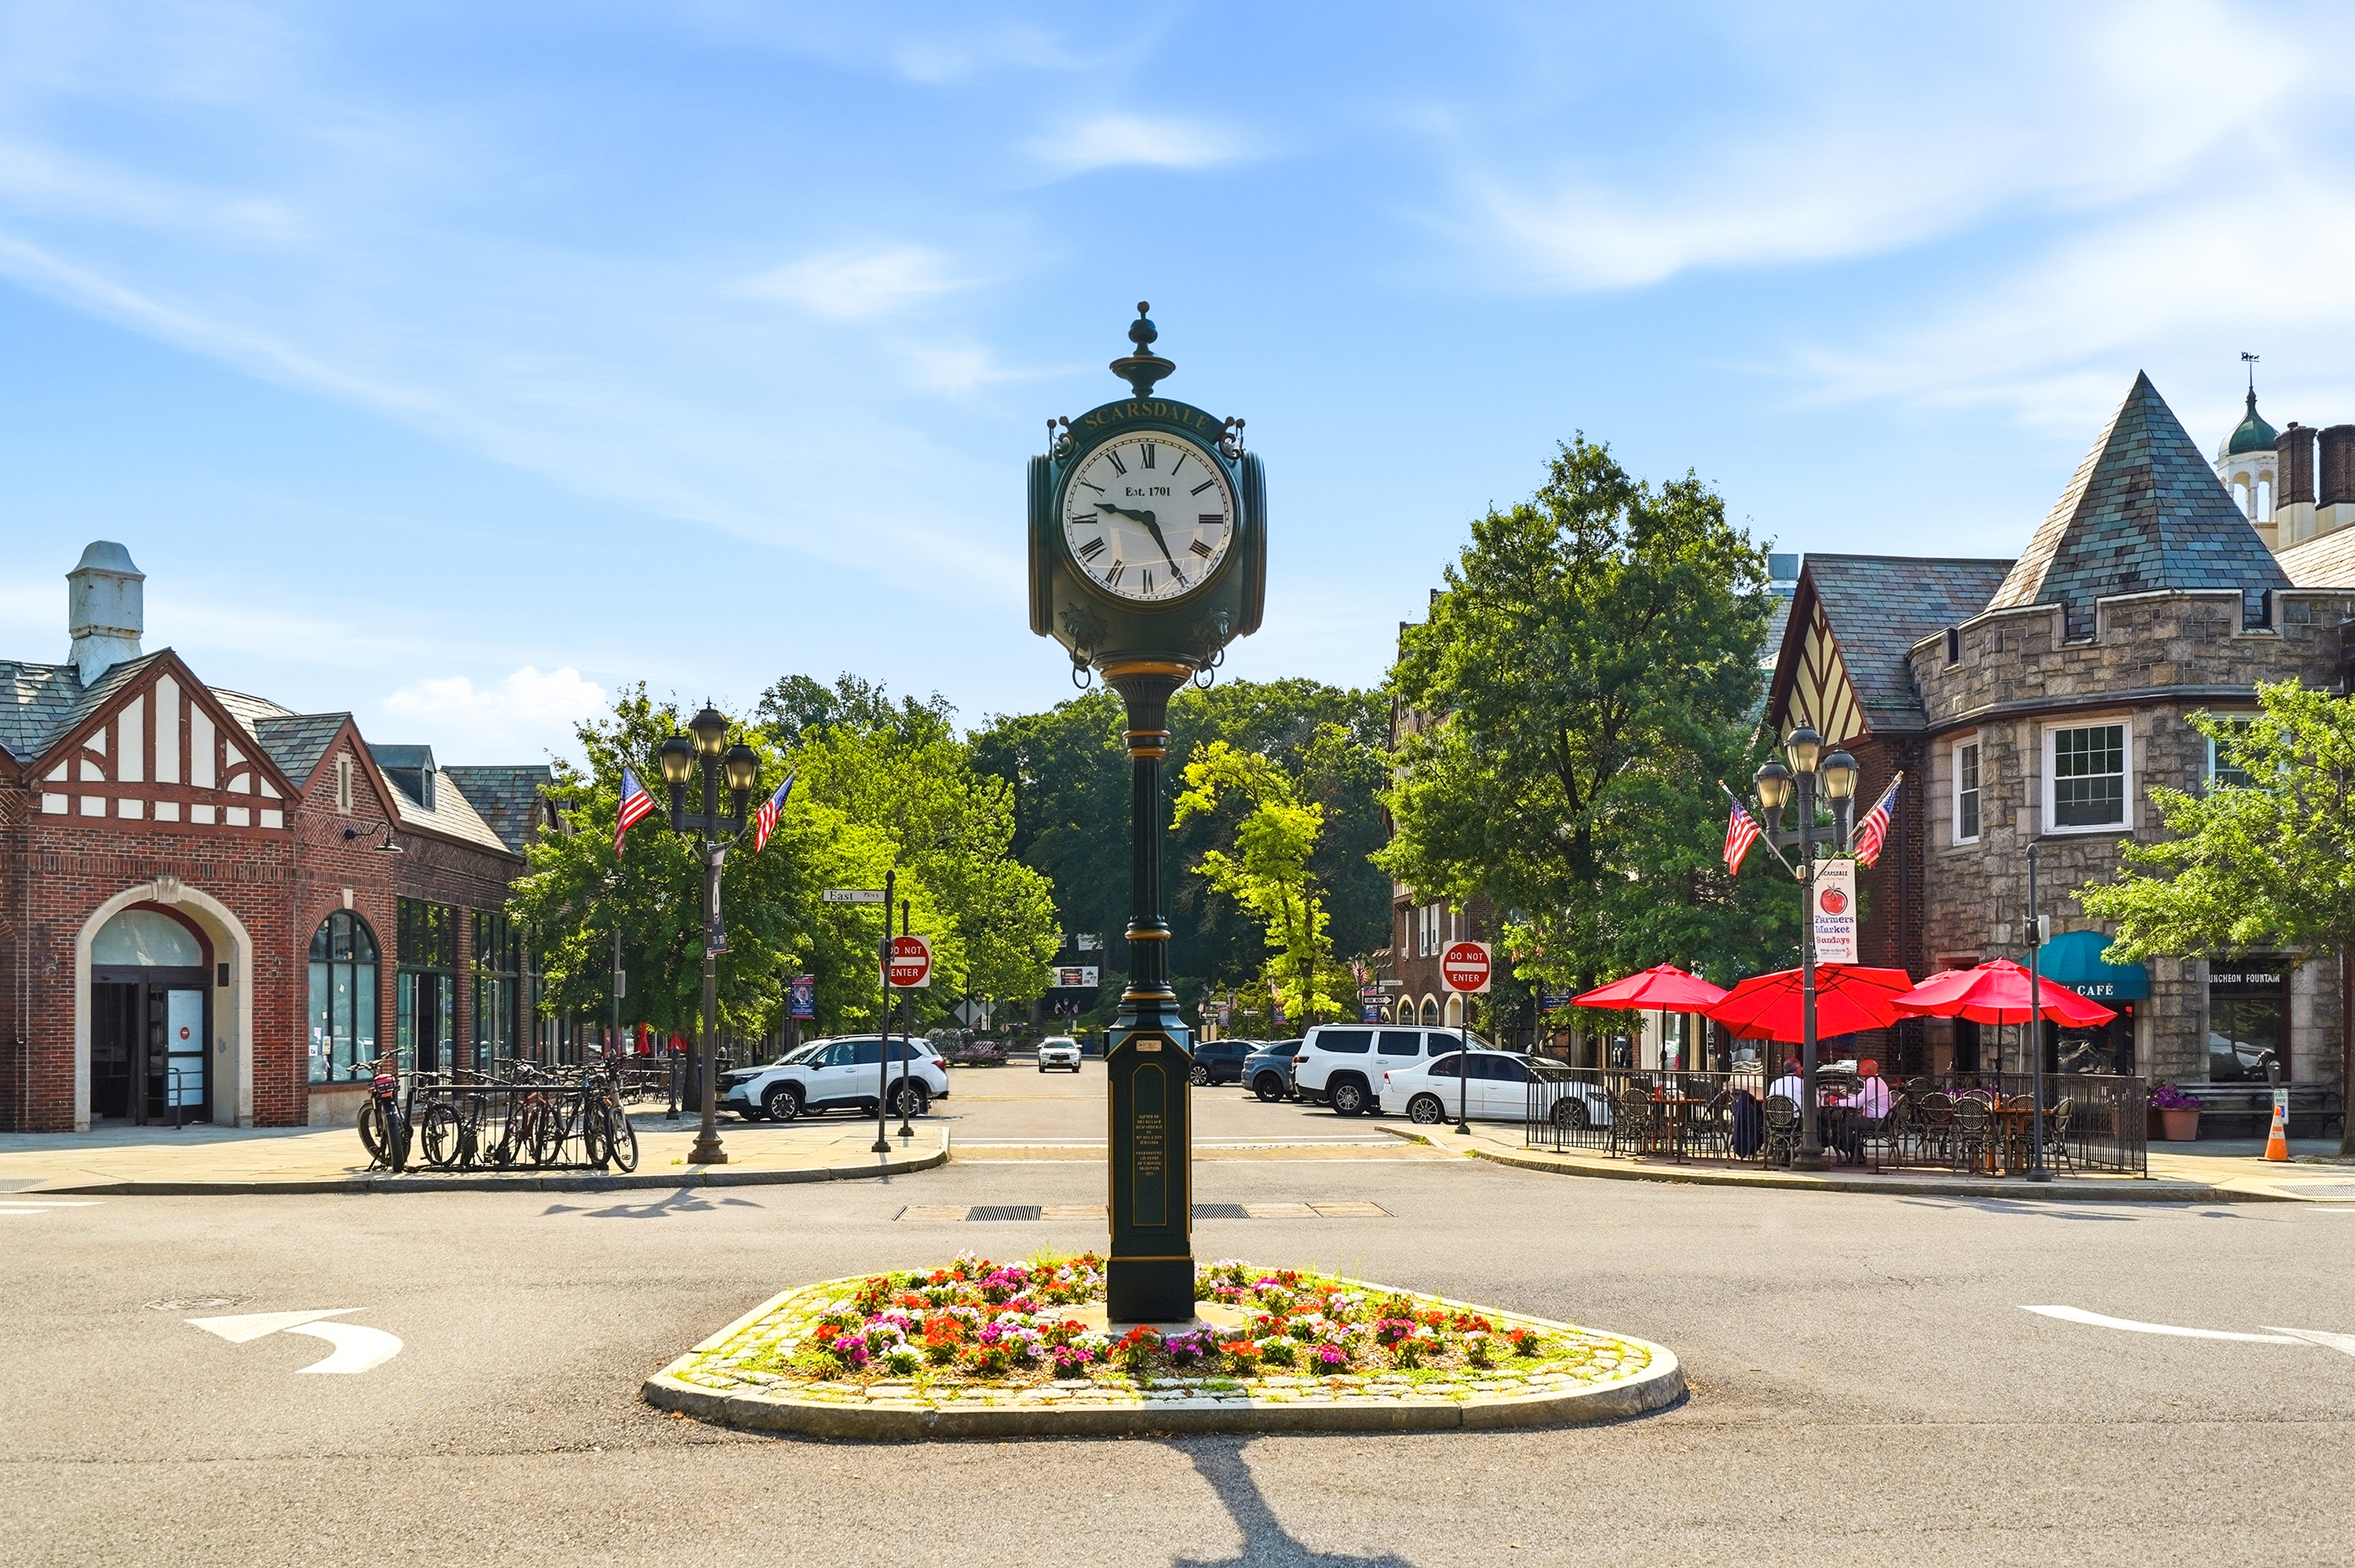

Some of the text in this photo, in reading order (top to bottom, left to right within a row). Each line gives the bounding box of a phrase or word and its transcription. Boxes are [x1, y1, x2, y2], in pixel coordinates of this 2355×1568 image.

[1084, 401, 1210, 431] SCARSDALE
[1140, 443, 1156, 469] XII
[1105, 450, 1127, 478] XI
[1079, 476, 1106, 497] X
[1190, 479, 1215, 496] II
[1125, 487, 1171, 497] Est. 1701
[1072, 511, 1098, 524] IX
[1198, 513, 1224, 524] III
[829, 891, 853, 901] East
[1814, 915, 1854, 924] Farmers
[1815, 925, 1850, 934] Market
[1816, 935, 1850, 946] Sundays
[904, 946, 922, 954] NOT
[1466, 952, 1484, 961] NOT
[891, 968, 918, 977] ENTER
[1453, 974, 1480, 983] ENTER
[2209, 974, 2280, 983] UNCHEON FOUNTAIN
[2077, 983, 2113, 997] CAFÉ
